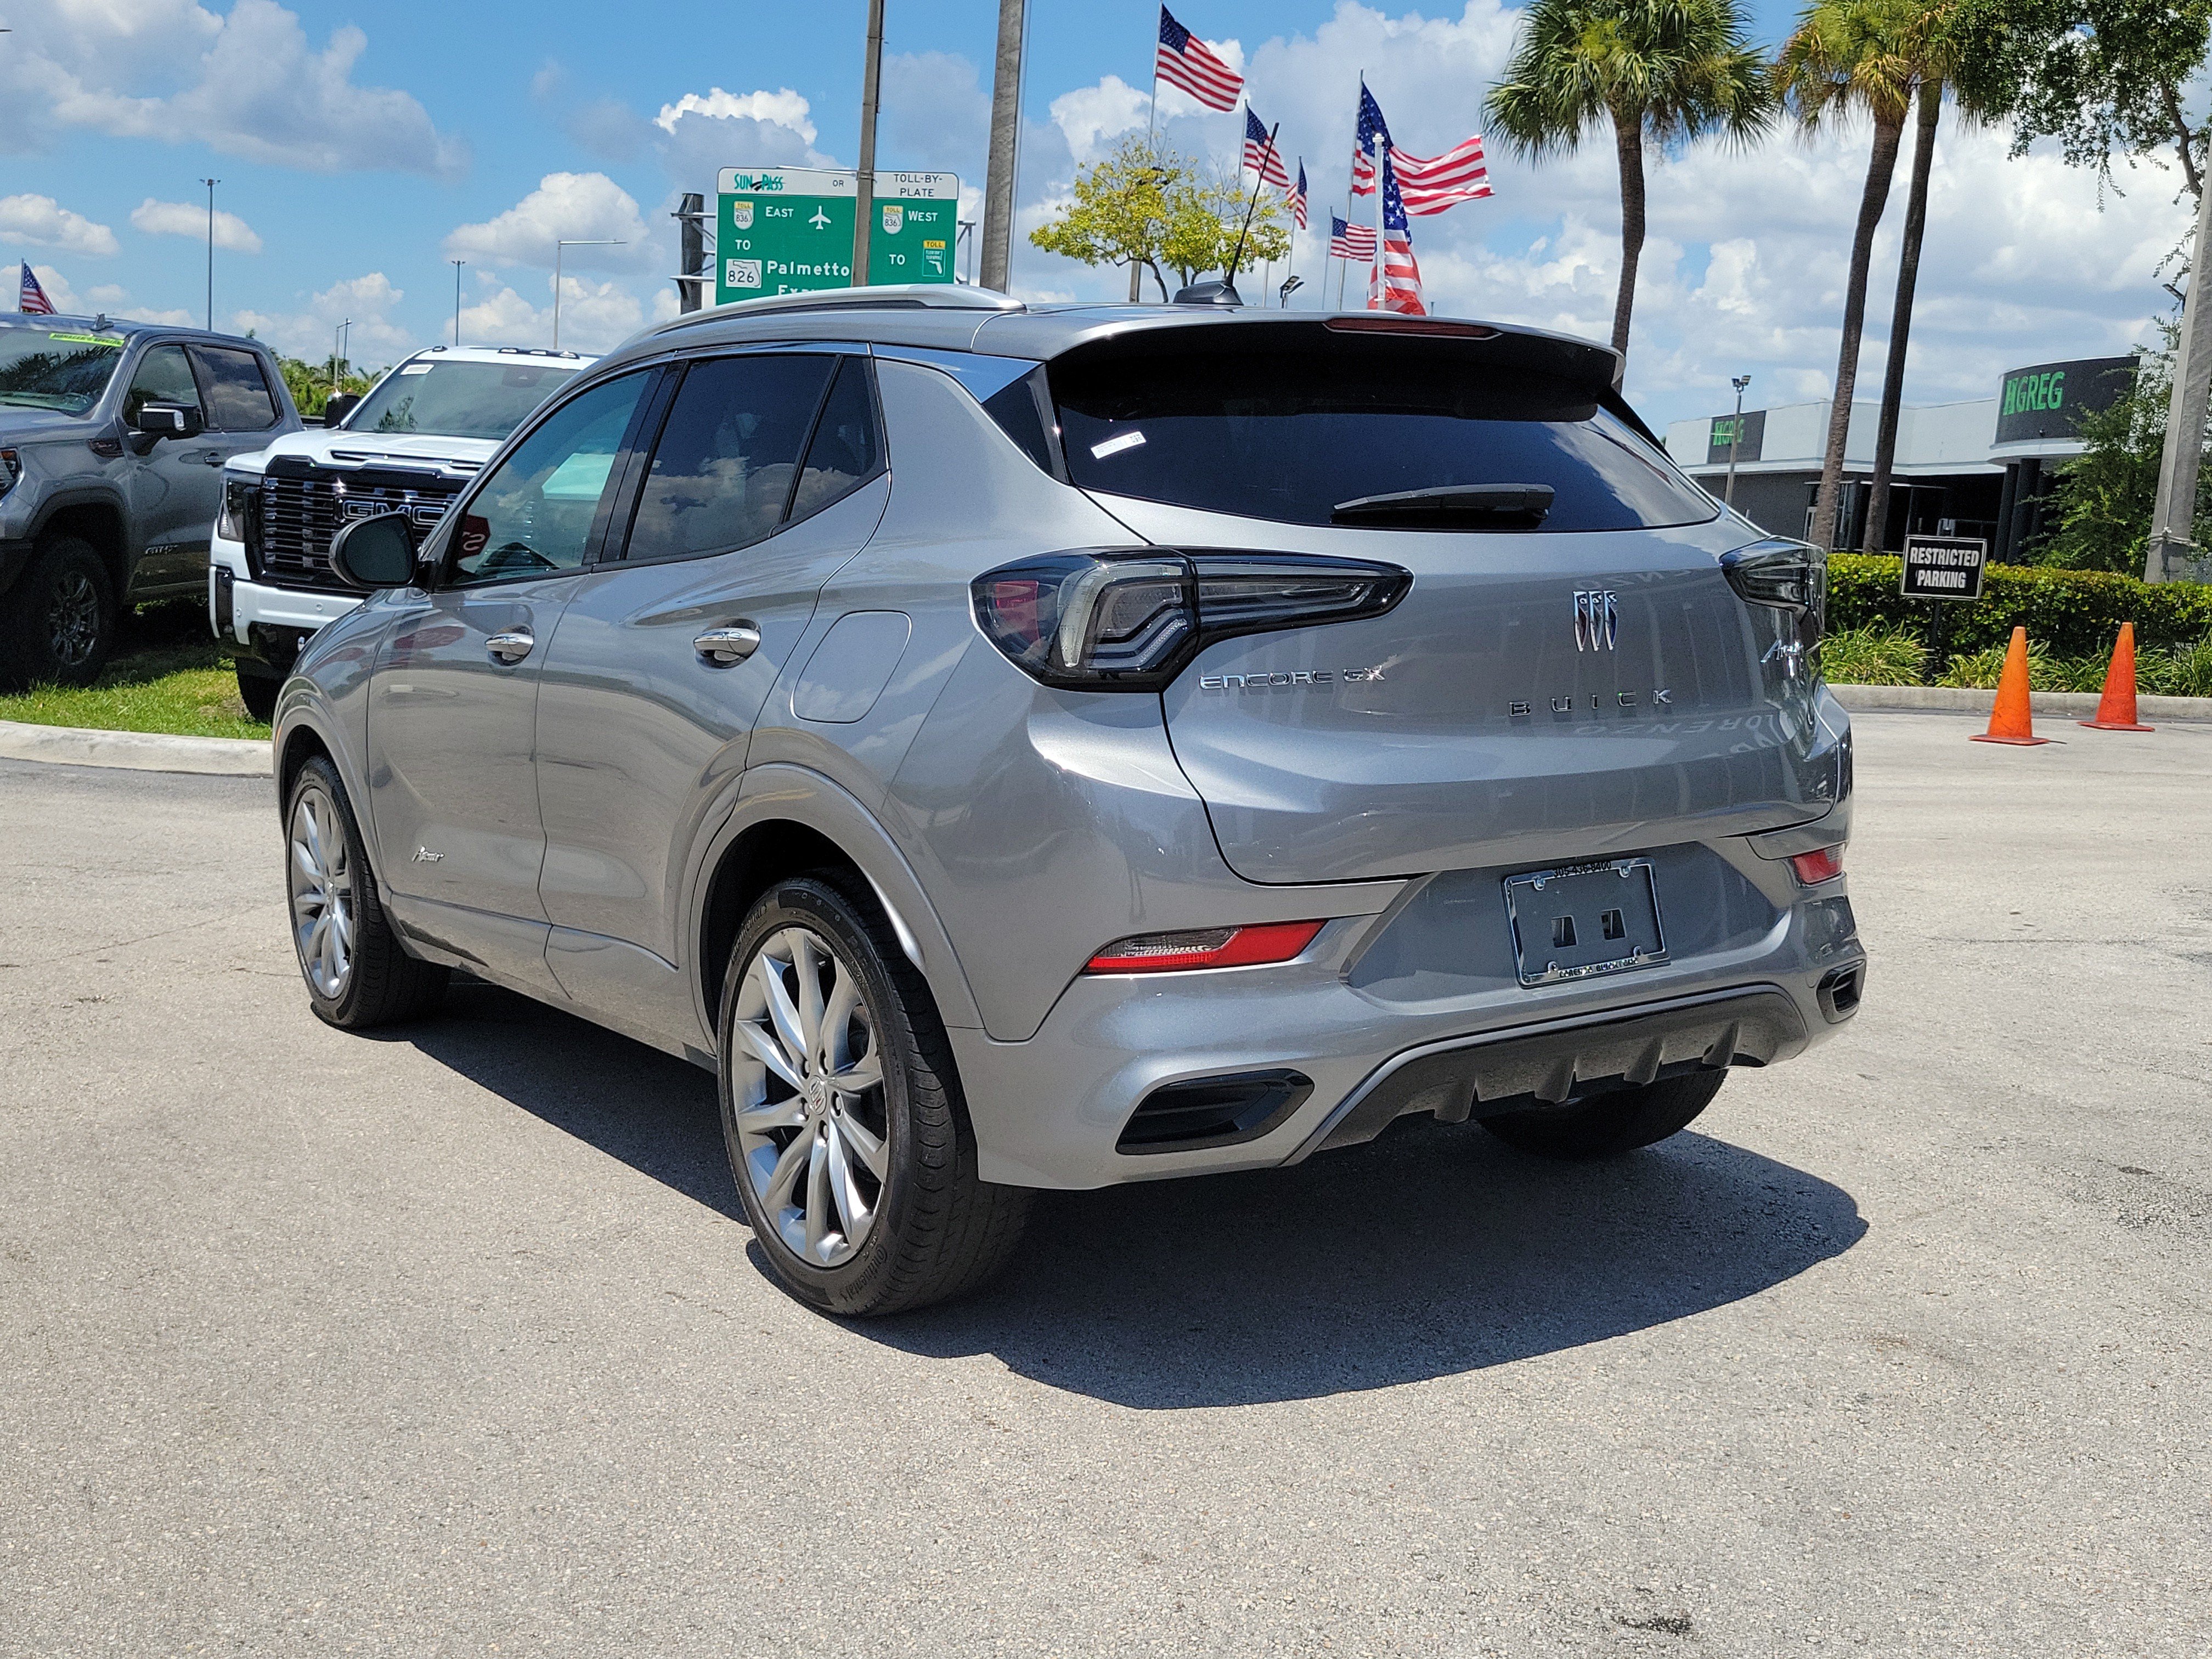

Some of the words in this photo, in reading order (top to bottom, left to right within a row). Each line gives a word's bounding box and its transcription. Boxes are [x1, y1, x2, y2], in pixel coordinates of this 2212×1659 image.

[893, 174, 943, 183] TOLL-BY-
[900, 188, 934, 197] PLATE
[736, 212, 749, 222] 836
[765, 206, 794, 218] EAST
[907, 210, 938, 222] WEST
[884, 218, 898, 227] 836
[735, 239, 751, 250] TO
[889, 253, 905, 266] TO
[766, 260, 850, 276] Palmetto
[728, 270, 754, 283] 826
[342, 499, 446, 526] GMC
[1909, 546, 1980, 567] RESTRICTED
[1916, 569, 1967, 589] PARKING
[1199, 670, 1334, 690] ENCORE
[1343, 665, 1386, 682] GX
[1509, 689, 1673, 717] BUICK
[1552, 861, 1612, 878] 305-436-8400
